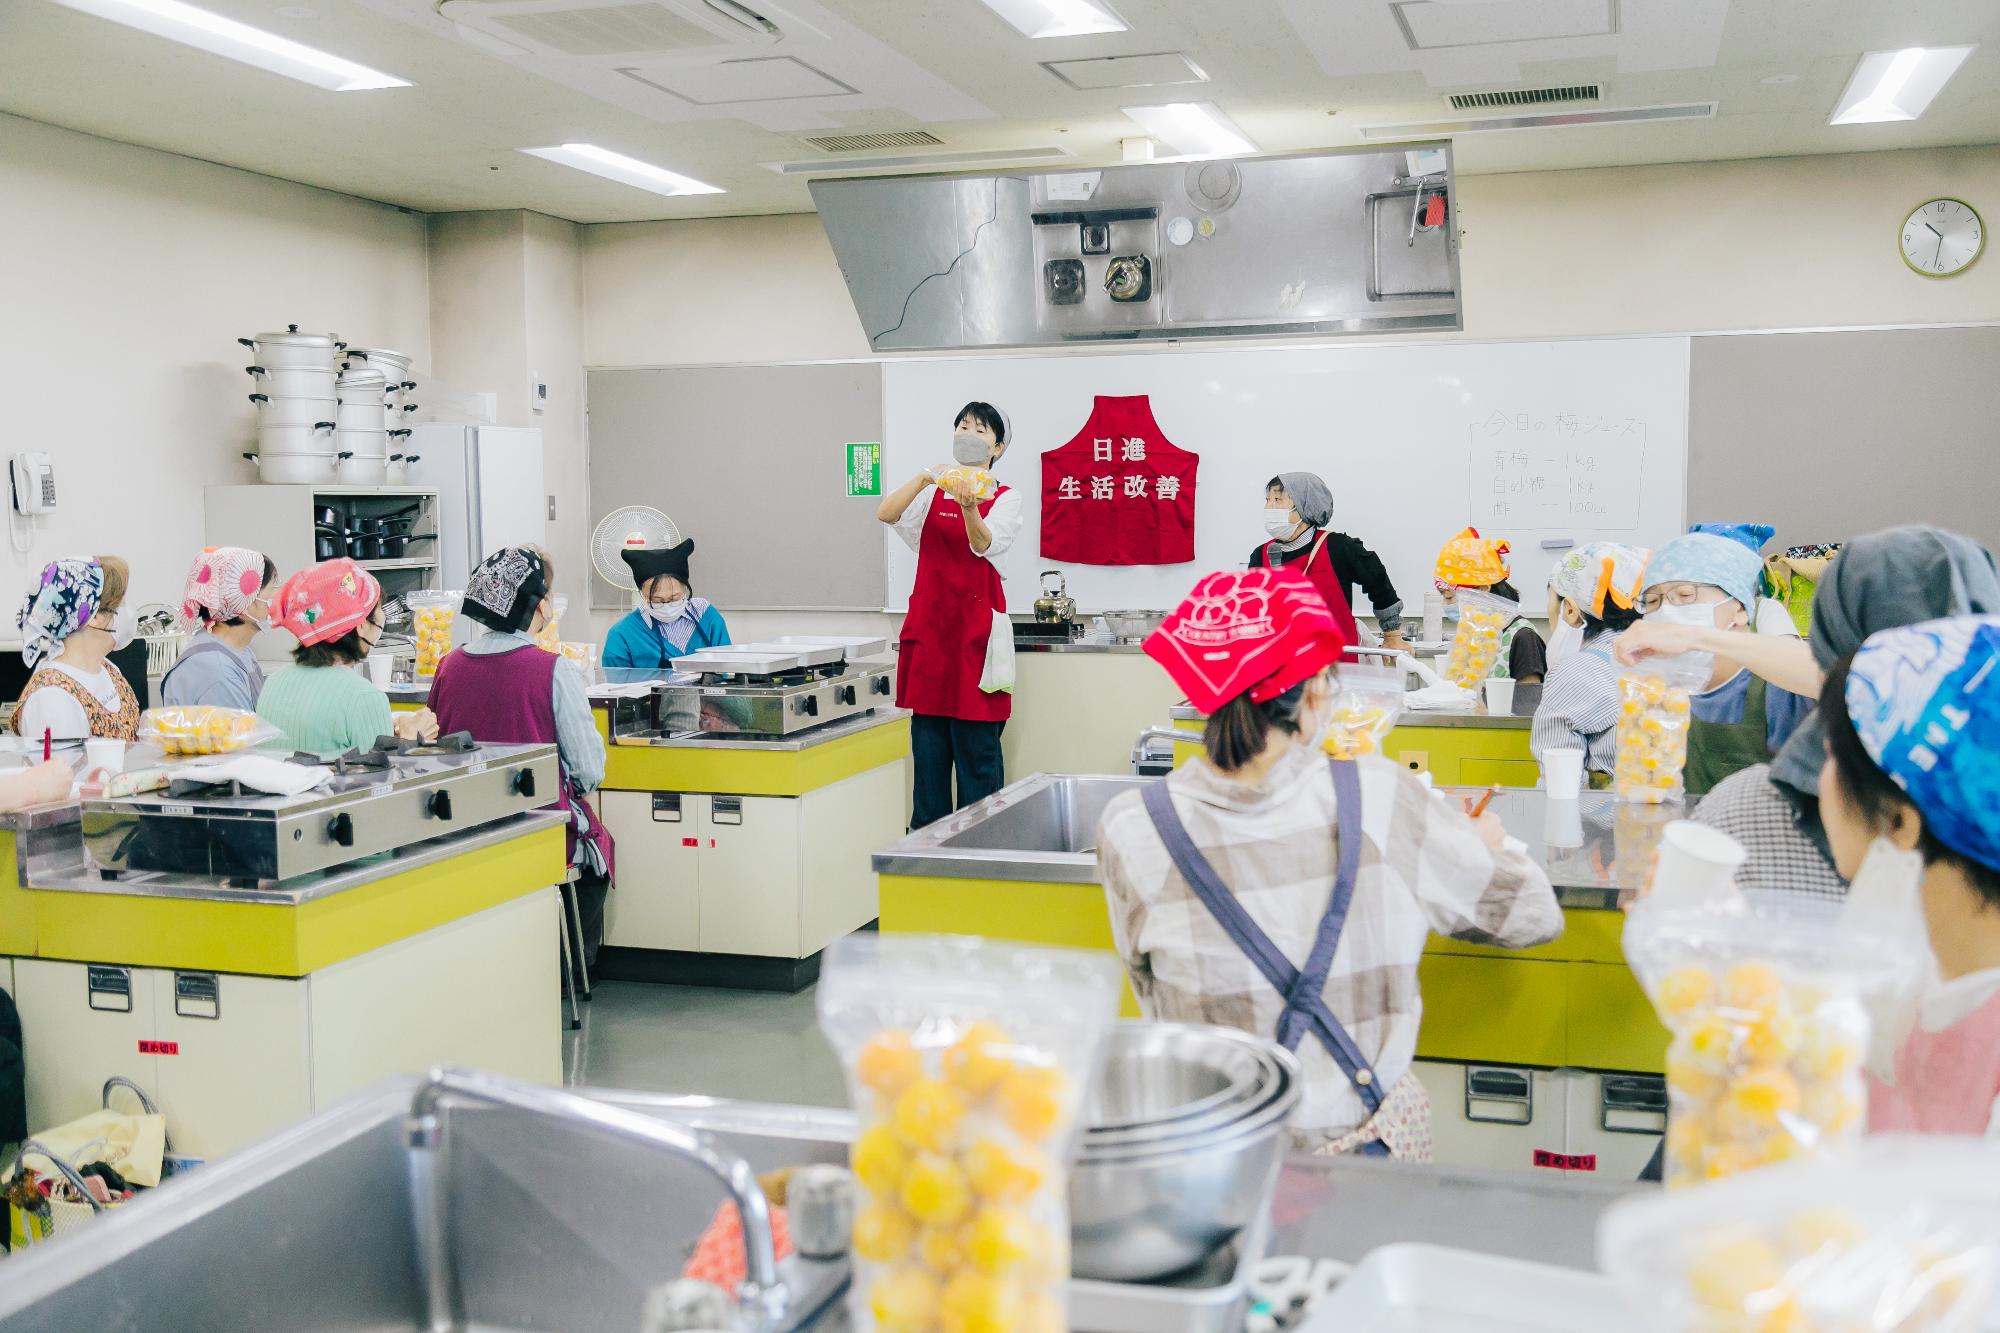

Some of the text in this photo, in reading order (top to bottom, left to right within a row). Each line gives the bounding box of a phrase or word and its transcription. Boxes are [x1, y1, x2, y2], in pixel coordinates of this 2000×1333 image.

[1937, 202, 1946, 213] 12
[1904, 234, 1912, 245] 9
[1972, 230, 1979, 240] 3
[1937, 261, 1945, 272] 6
[1093, 437, 1147, 462] 日進
[1058, 474, 1181, 501] 生活改善
